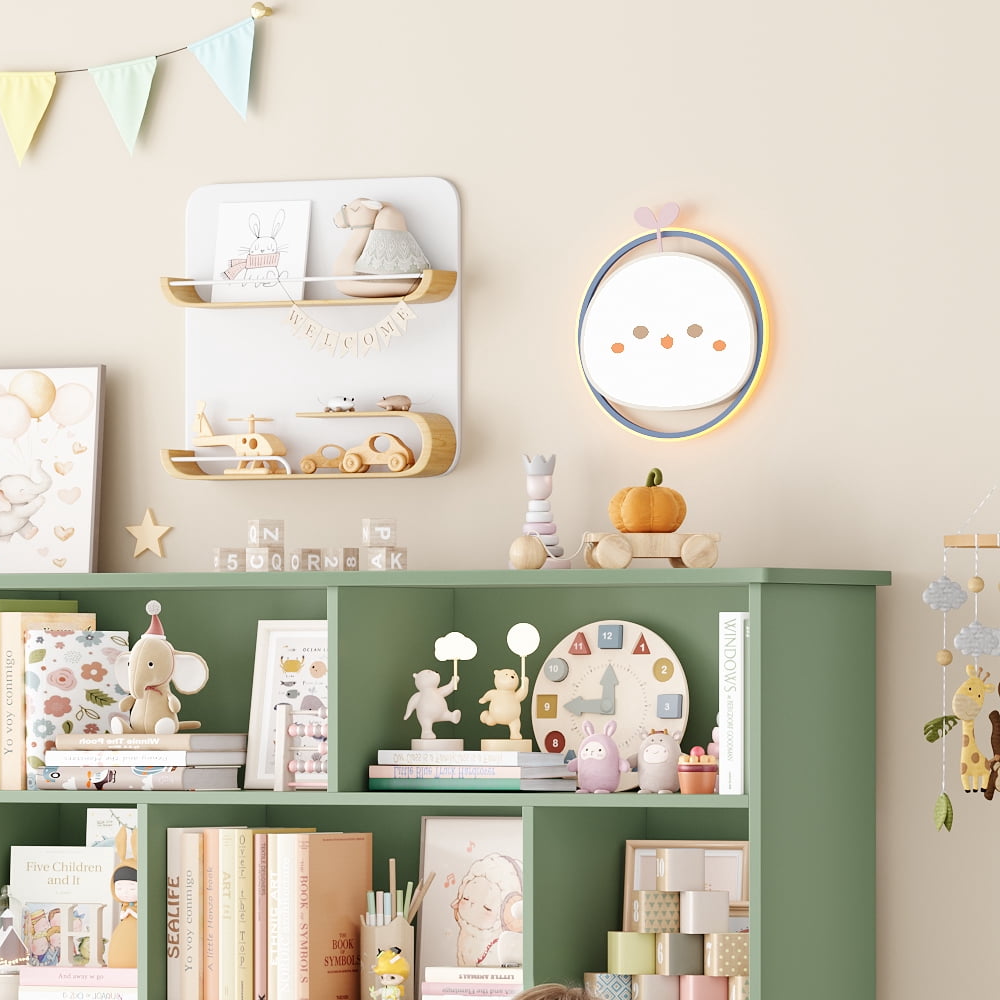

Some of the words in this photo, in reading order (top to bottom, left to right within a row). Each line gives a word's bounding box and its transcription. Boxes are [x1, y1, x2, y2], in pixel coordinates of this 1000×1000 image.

[289, 309, 410, 349] WELCOME
[227, 554, 239, 570] 5
[308, 555, 322, 570] R
[391, 553, 404, 570] K
[602, 632, 613, 640] 12
[640, 644, 645, 652] 1
[723, 618, 737, 693] WINDOWS
[549, 664, 560, 672] 10
[661, 665, 668, 675] 2
[6, 649, 15, 706] conmigo
[543, 702, 550, 711] 9
[664, 703, 671, 711] 3
[6, 711, 16, 734] voy
[4, 738, 13, 755] Yo
[552, 738, 559, 748] 8
[26, 861, 50, 872] Five
[52, 861, 103, 872] Children
[47, 876, 70, 885] and
[72, 876, 81, 885] It
[222, 872, 231, 899] ART
[186, 869, 195, 924] conmigo
[300, 875, 309, 909] BOOK
[168, 876, 180, 959] SEALIFE
[186, 928, 195, 951] voy
[332, 939, 354, 950] BOOK
[300, 922, 309, 984] SYMBOLS
[324, 955, 361, 967] SYMBOLS
[185, 955, 193, 972] Yo
